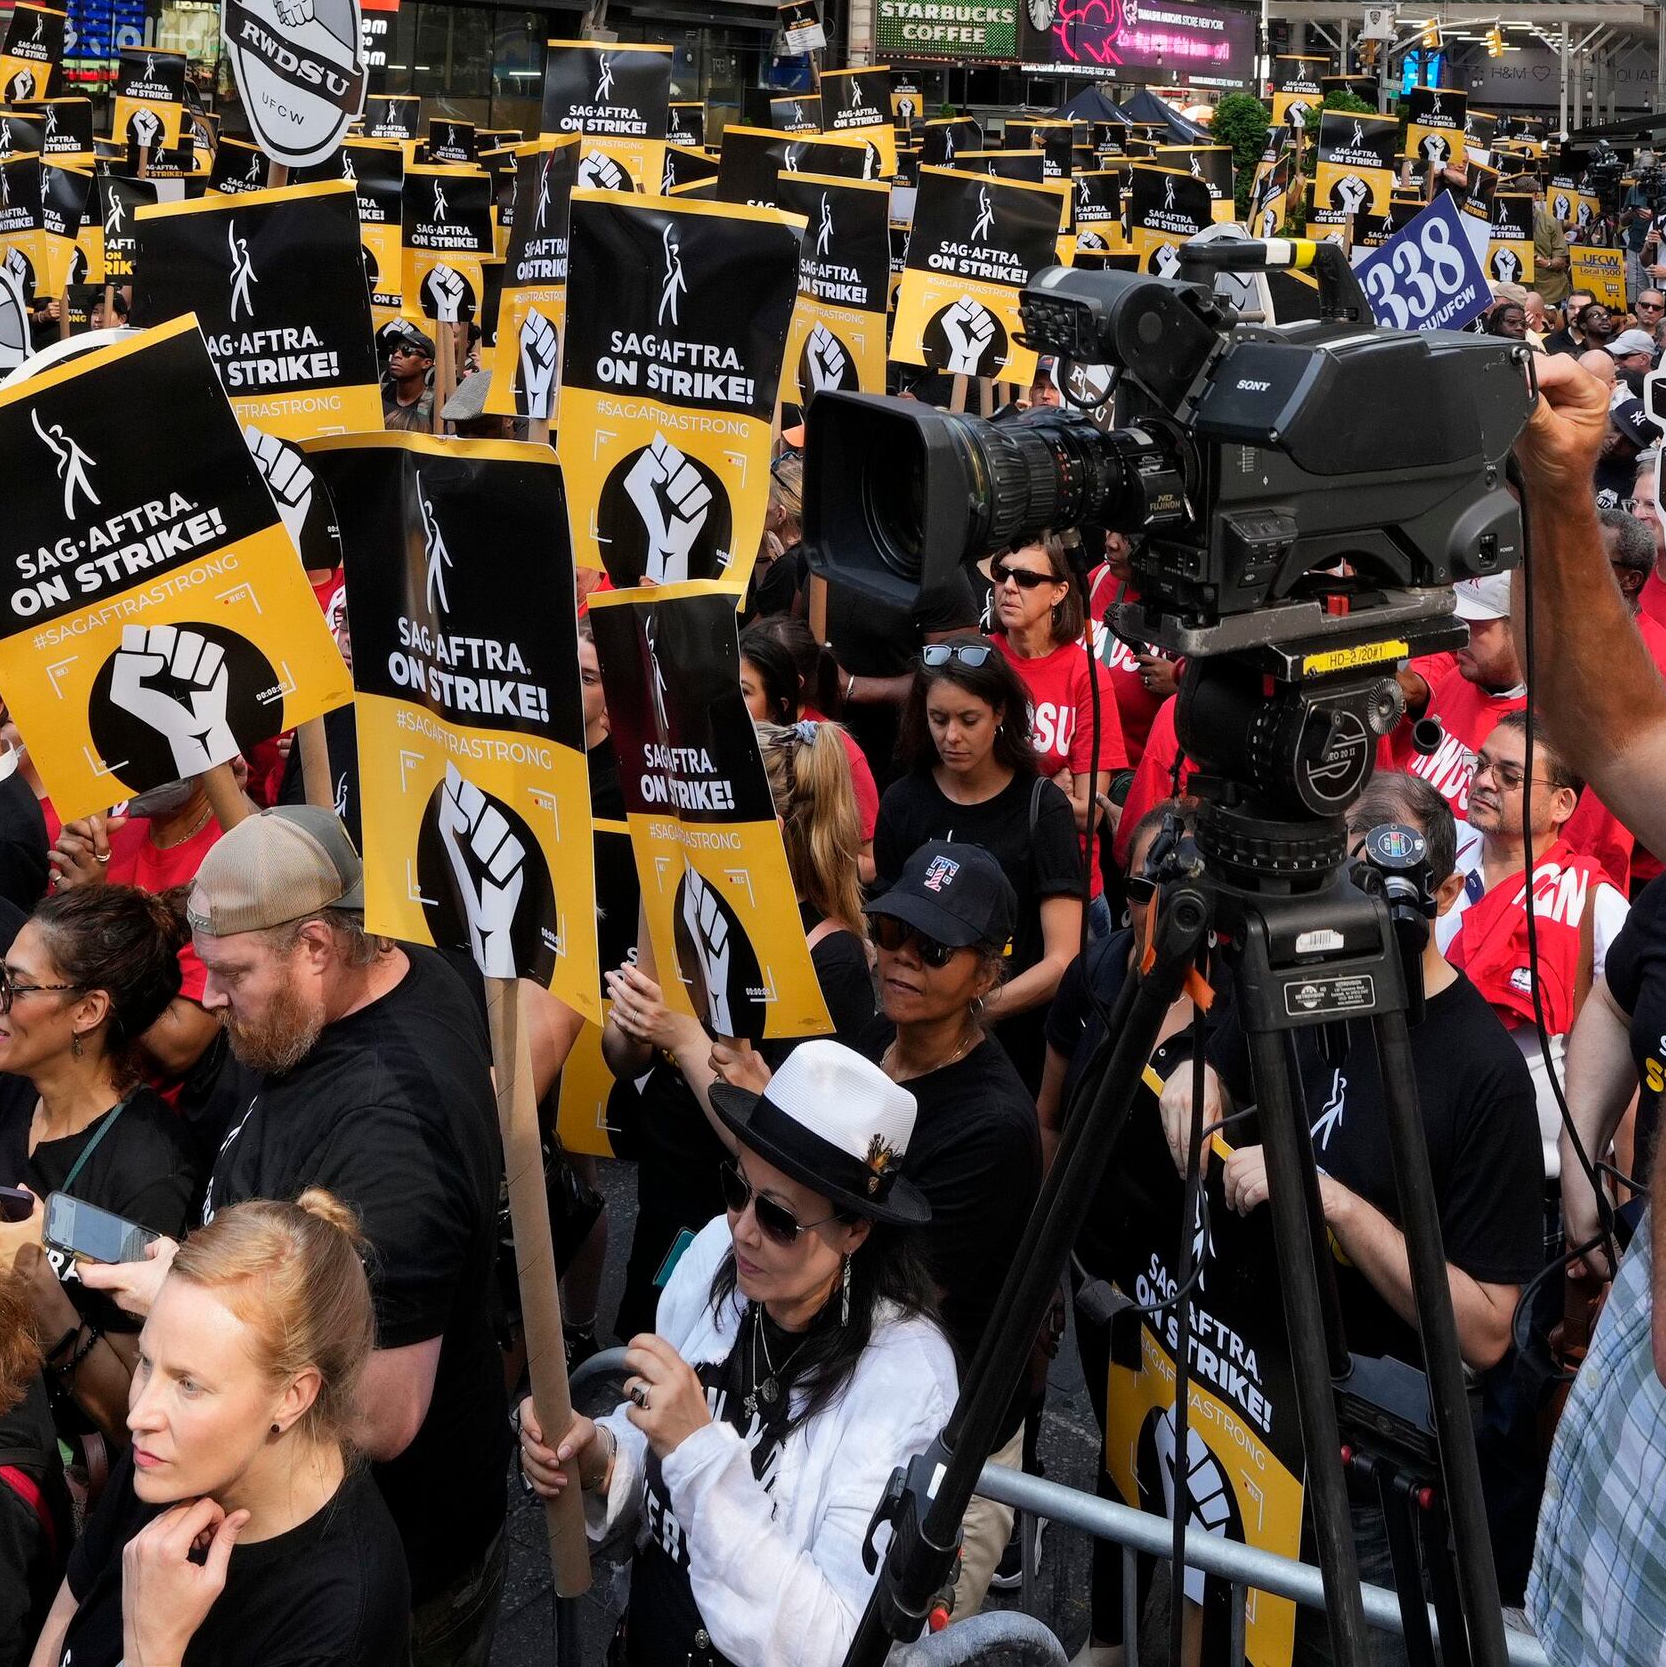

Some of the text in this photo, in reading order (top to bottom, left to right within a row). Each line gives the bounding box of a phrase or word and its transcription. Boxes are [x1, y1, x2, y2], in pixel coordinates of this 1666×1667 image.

[881, 1, 1015, 24] STARBUCKS
[903, 23, 985, 45] COFFEE
[240, 20, 350, 96] RWDSU
[262, 92, 304, 125] UFCW
[560, 117, 648, 135] ON STRIKE!
[928, 254, 1028, 284] ON STRIKE!
[1580, 267, 1621, 276] Local 1500
[1583, 252, 1619, 265] UFCW
[228, 352, 340, 387] STRIKE!
[597, 358, 755, 405] ON STRIKE!
[1237, 380, 1270, 392] SONY
[1150, 498, 1181, 510] FUJINON
[11, 507, 227, 620] ON STRIKE!
[388, 655, 549, 723] ON STRIKE!
